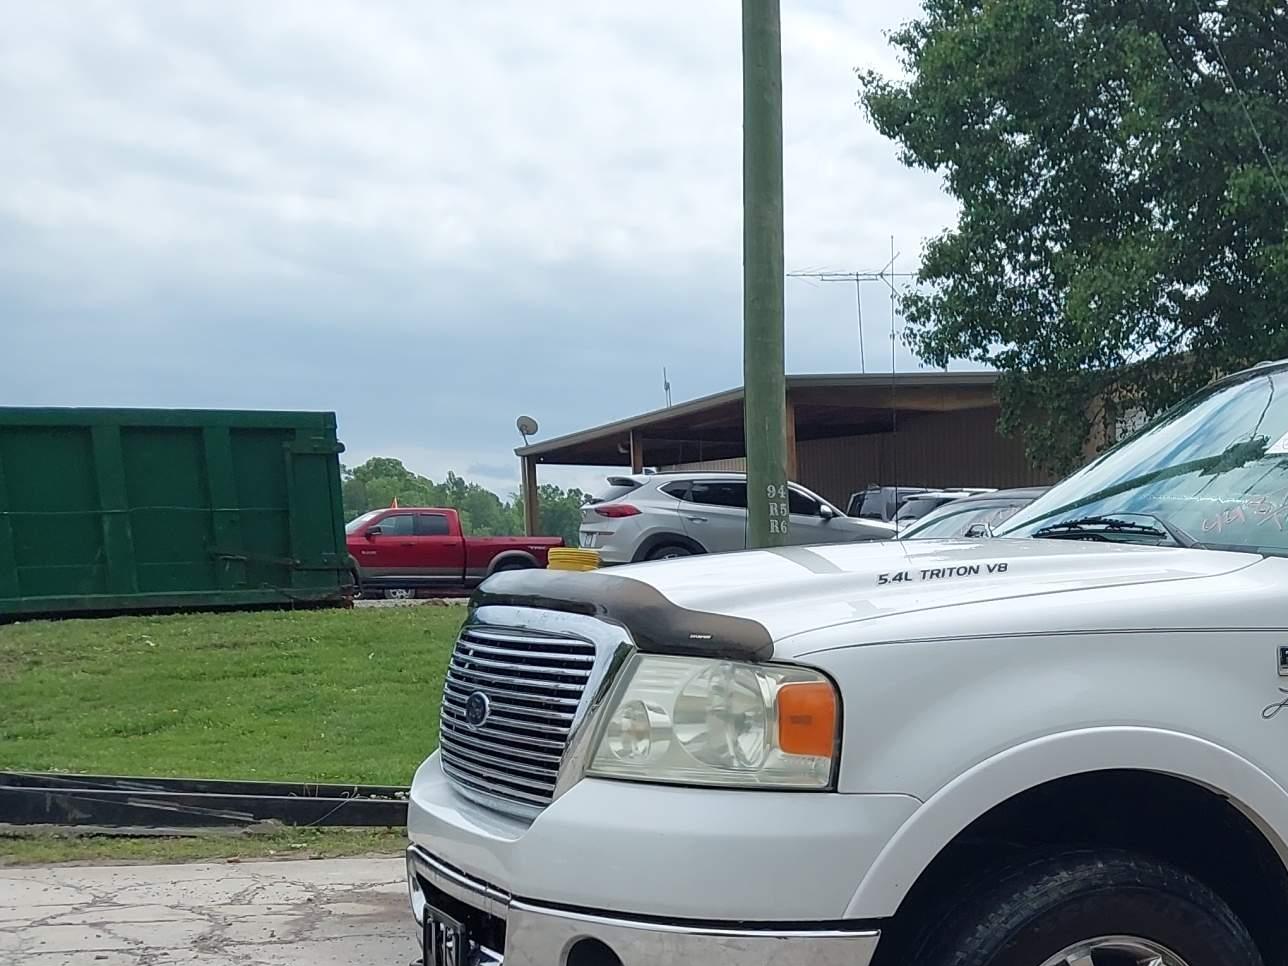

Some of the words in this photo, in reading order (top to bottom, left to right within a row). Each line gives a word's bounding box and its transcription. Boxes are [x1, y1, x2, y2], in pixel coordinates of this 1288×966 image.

[767, 484, 786, 499] 94
[768, 502, 787, 517] R5
[769, 519, 788, 534] R6
[877, 572, 913, 585] 5.4L
[920, 564, 981, 580] TRITON
[986, 562, 1008, 574] V8
